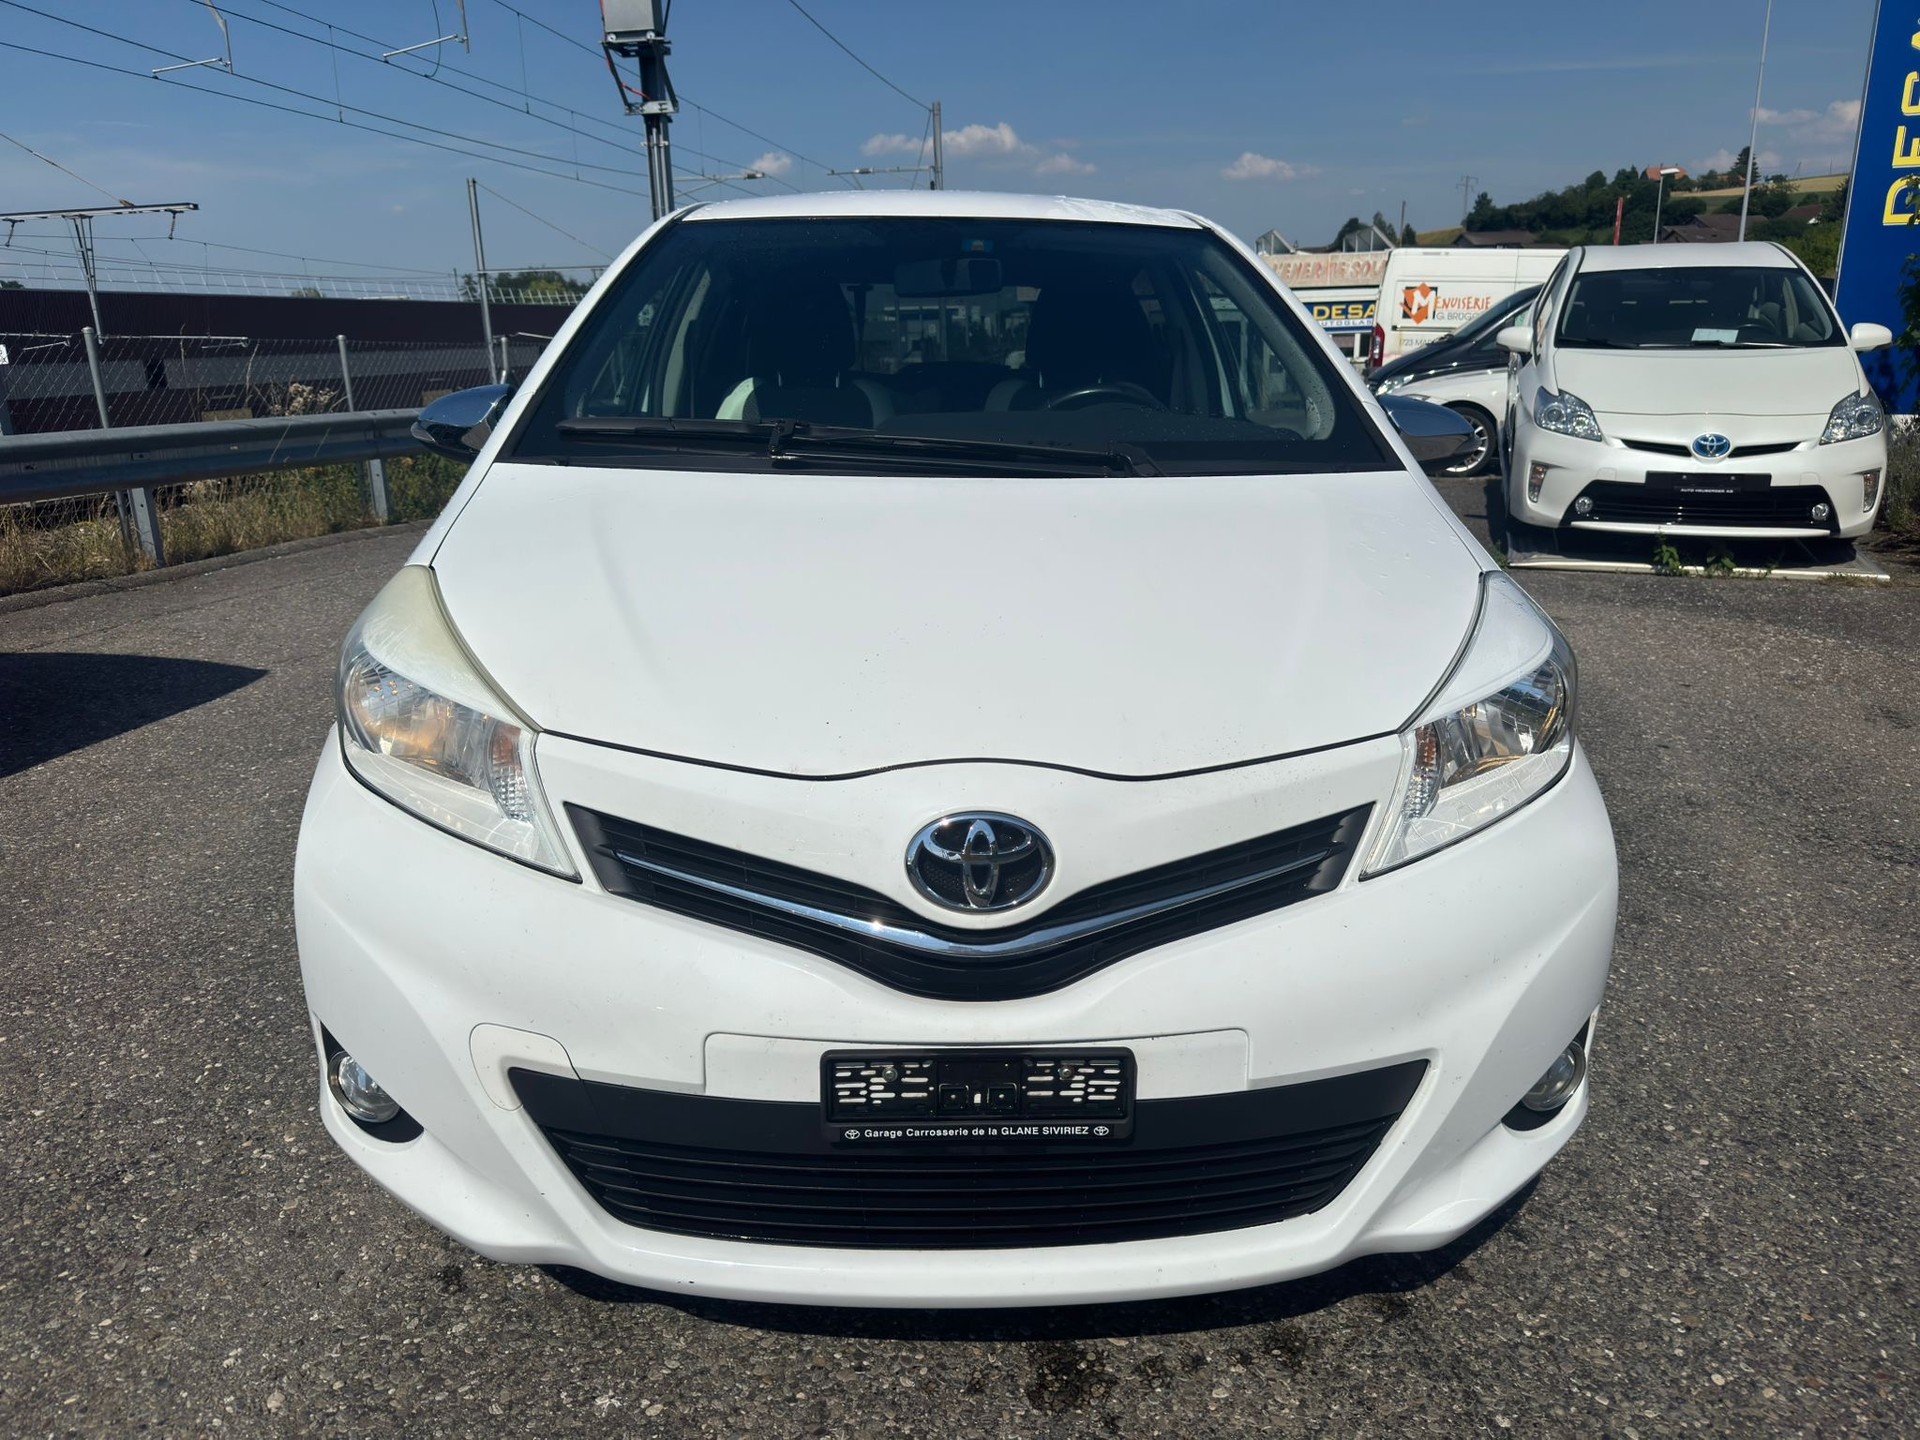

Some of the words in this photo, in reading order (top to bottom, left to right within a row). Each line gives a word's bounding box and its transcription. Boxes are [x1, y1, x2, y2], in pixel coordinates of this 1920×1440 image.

[864, 1128, 903, 1139] Garage
[906, 1127, 969, 1137] Carrosserie
[971, 1127, 985, 1136] de
[988, 1127, 998, 1136] la
[1001, 1126, 1039, 1136] GLANE
[1042, 1126, 1089, 1135] SIVIRIEZ
